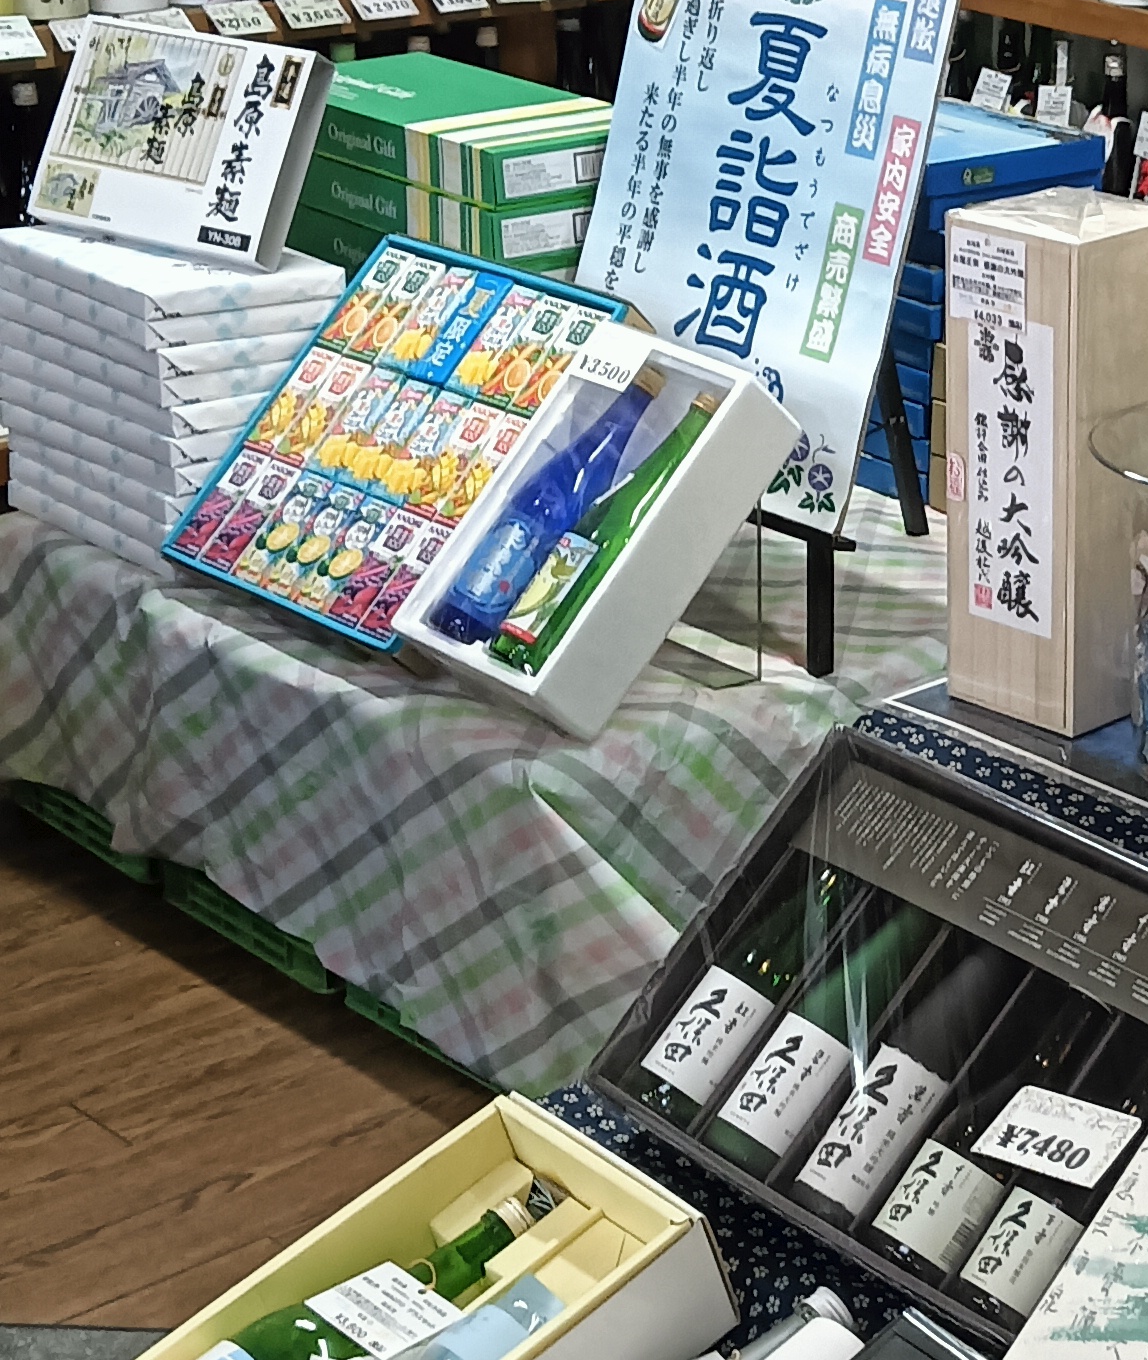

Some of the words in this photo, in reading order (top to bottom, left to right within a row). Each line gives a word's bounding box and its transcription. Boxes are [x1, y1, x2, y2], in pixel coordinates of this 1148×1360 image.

[851, 5, 902, 154] 無病息災
[204, 52, 276, 222] 島原素麺
[328, 123, 372, 154] Original
[373, 136, 396, 159] Gift
[331, 181, 373, 212] Original
[375, 196, 397, 220] Gift
[674, 11, 829, 360] 夏詣酒
[866, 124, 918, 262] 家内安全
[805, 210, 862, 354] 商売繁盛
[993, 334, 1040, 623] 感謝の大吟醸
[663, 986, 729, 1067] 久保田
[739, 1034, 803, 1118] 久保田
[815, 1062, 898, 1170] 久保田
[887, 1149, 945, 1226] 久保田
[996, 1121, 1093, 1172] ¥7,480
[976, 1199, 1034, 1277] 久保田
